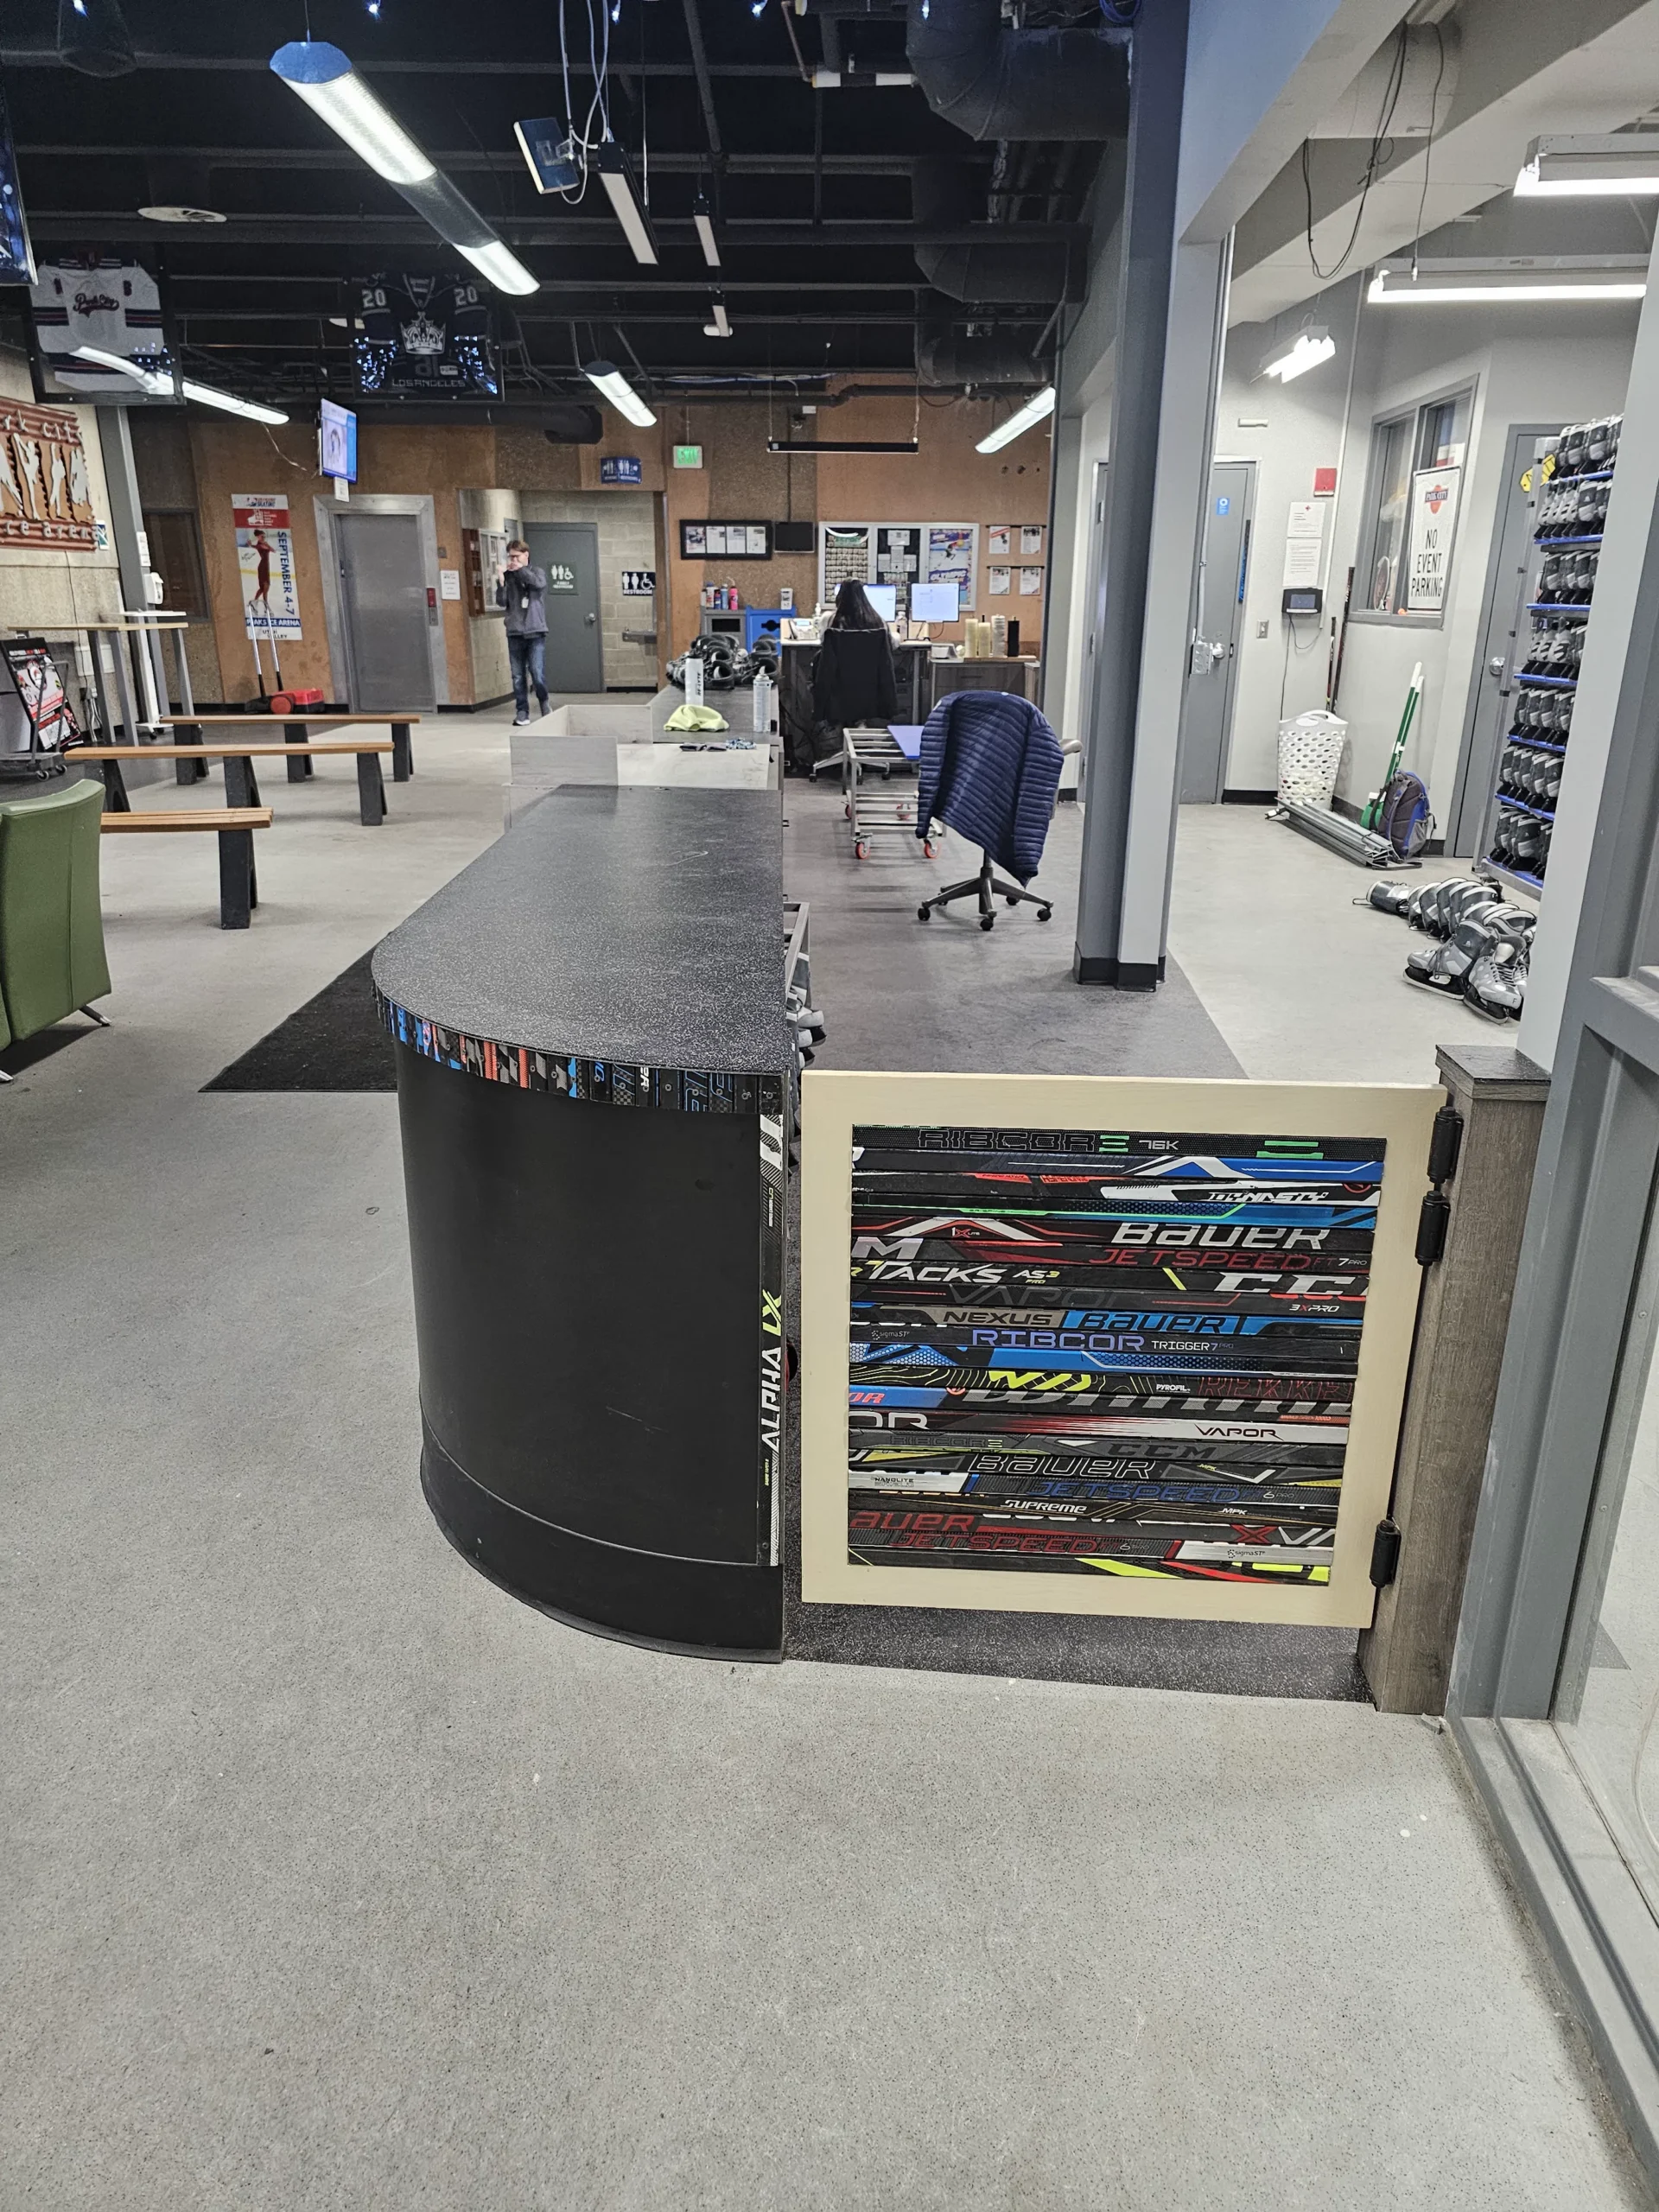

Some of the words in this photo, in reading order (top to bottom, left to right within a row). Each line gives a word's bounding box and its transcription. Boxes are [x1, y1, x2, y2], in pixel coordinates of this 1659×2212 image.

[362, 289, 386, 308] 20
[454, 287, 478, 306] 20
[391, 378, 412, 387] LOS
[1426, 529, 1438, 549] NO
[277, 531, 293, 594] SEPTEMBER
[285, 596, 295, 615] 4-7
[1417, 553, 1442, 574] EVENT
[1411, 577, 1443, 598] PARKING
[1139, 1140, 1179, 1151] 76K
[1110, 1222, 1330, 1250] BAUER
[1089, 1248, 1310, 1271] JETSPEED
[868, 1261, 1007, 1284] TACKS
[1012, 1269, 1061, 1279] AS3
[1214, 1272, 1370, 1295] CC
[762, 1288, 782, 1337] LX
[943, 1311, 1053, 1325] NEXUS
[1081, 1313, 1228, 1334] BAUER
[972, 1329, 1145, 1351] RIBCOR
[1151, 1340, 1210, 1351] TRIGGER
[1156, 1383, 1187, 1392] PYROFIL
[1198, 1376, 1353, 1402] REKKE
[761, 1346, 781, 1453] ALPHA
[1194, 1423, 1284, 1441] VAPOR
[1108, 1444, 1217, 1459] CCM
[968, 1452, 1156, 1478] BAUER
[1027, 1482, 1240, 1503] JETSPEED
[1001, 1499, 1088, 1513] SUPREME
[1221, 1507, 1248, 1516] MPK
[890, 1532, 1097, 1554] JETSPEED
